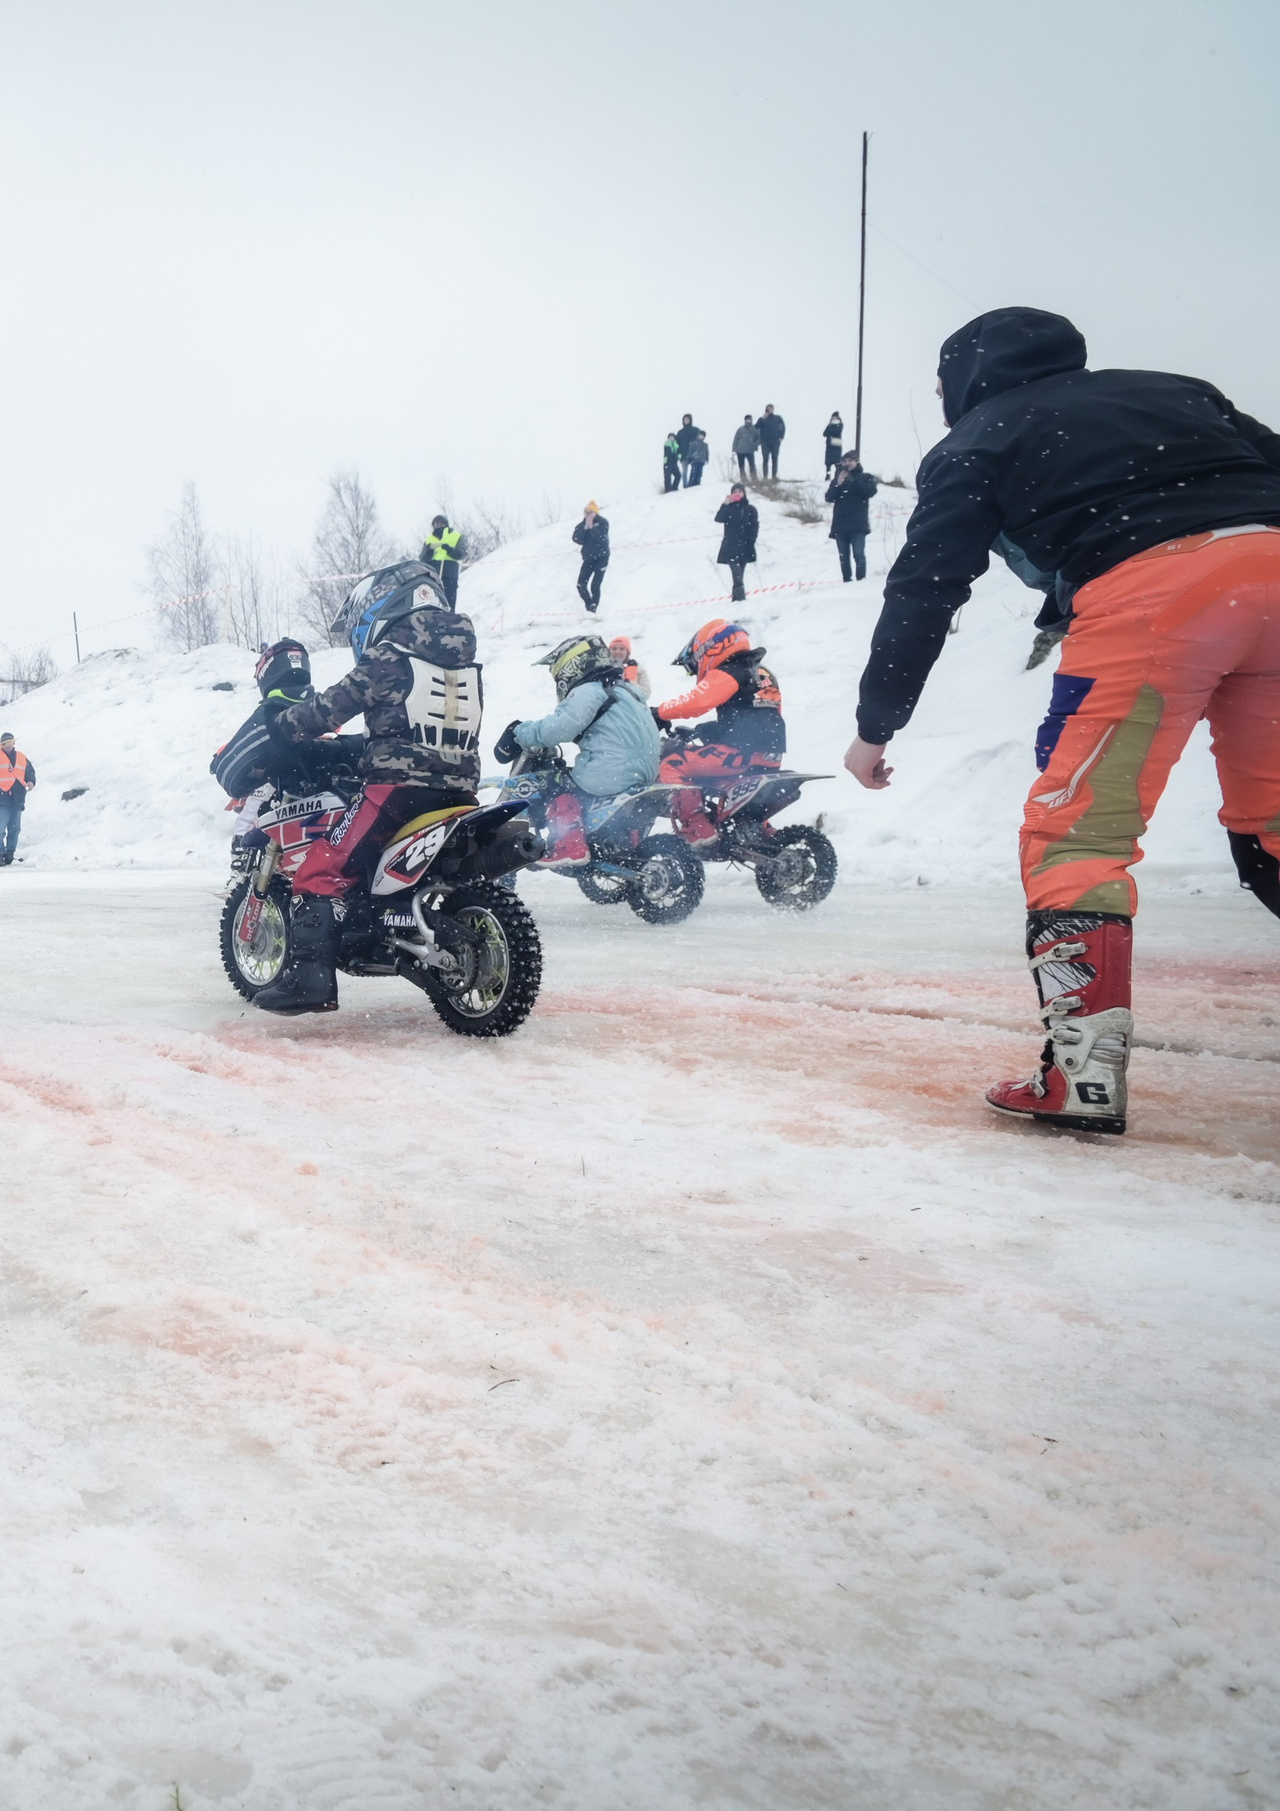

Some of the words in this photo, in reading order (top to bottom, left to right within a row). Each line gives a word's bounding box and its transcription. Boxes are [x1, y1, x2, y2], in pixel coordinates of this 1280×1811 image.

[275, 800, 323, 820] YAMAHA
[405, 826, 446, 871] 29
[246, 901, 261, 941] DULOP
[383, 914, 417, 927] YAMAHA
[1075, 1082, 1110, 1105] G
